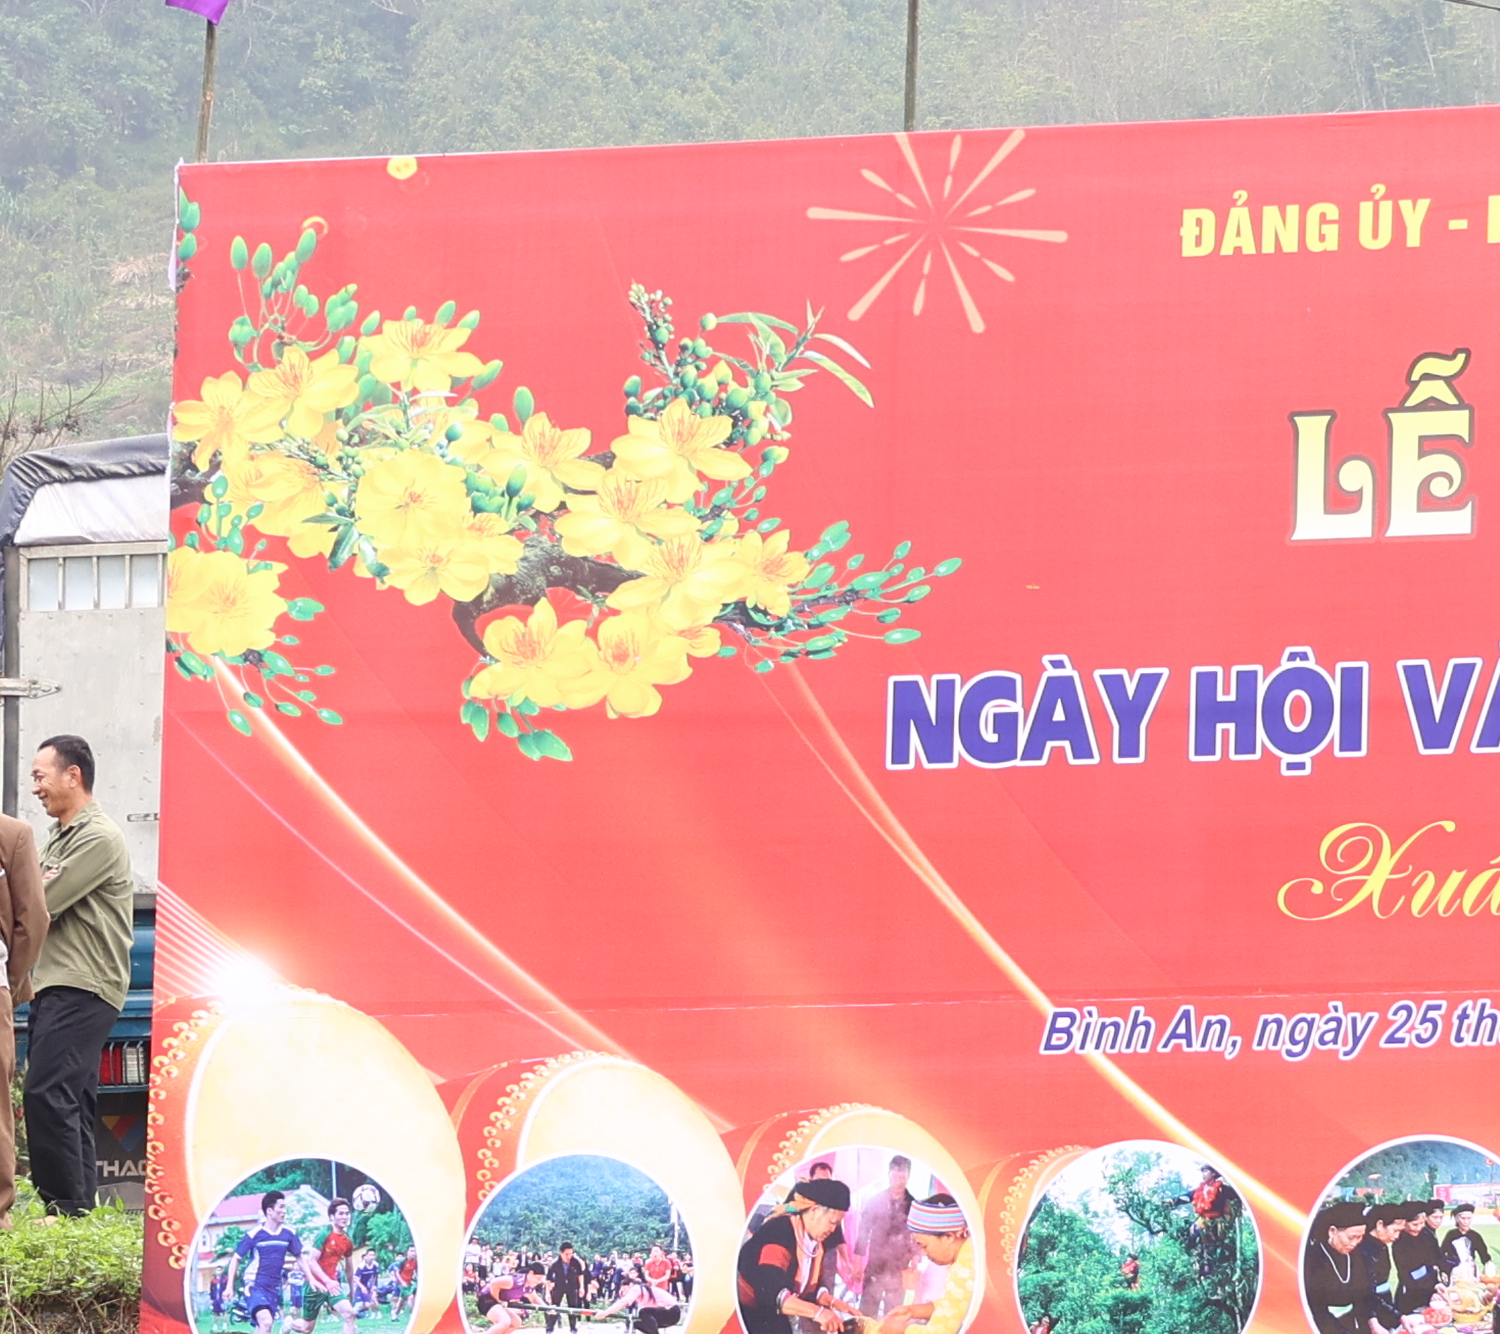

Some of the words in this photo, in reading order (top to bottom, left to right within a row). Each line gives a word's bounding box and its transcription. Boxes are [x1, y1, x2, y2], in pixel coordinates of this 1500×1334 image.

[1179, 189, 1340, 258] ĐẢNG
[1358, 183, 1432, 250] ỦY
[1290, 353, 1473, 541] LỄ
[888, 656, 1167, 768] NGÀY
[1190, 648, 1367, 774] HỘI
[1041, 1007, 1154, 1054] Bình
[1159, 1006, 1240, 1057] An,
[1254, 1003, 1376, 1060] ngày
[1381, 1001, 1445, 1047] 25
